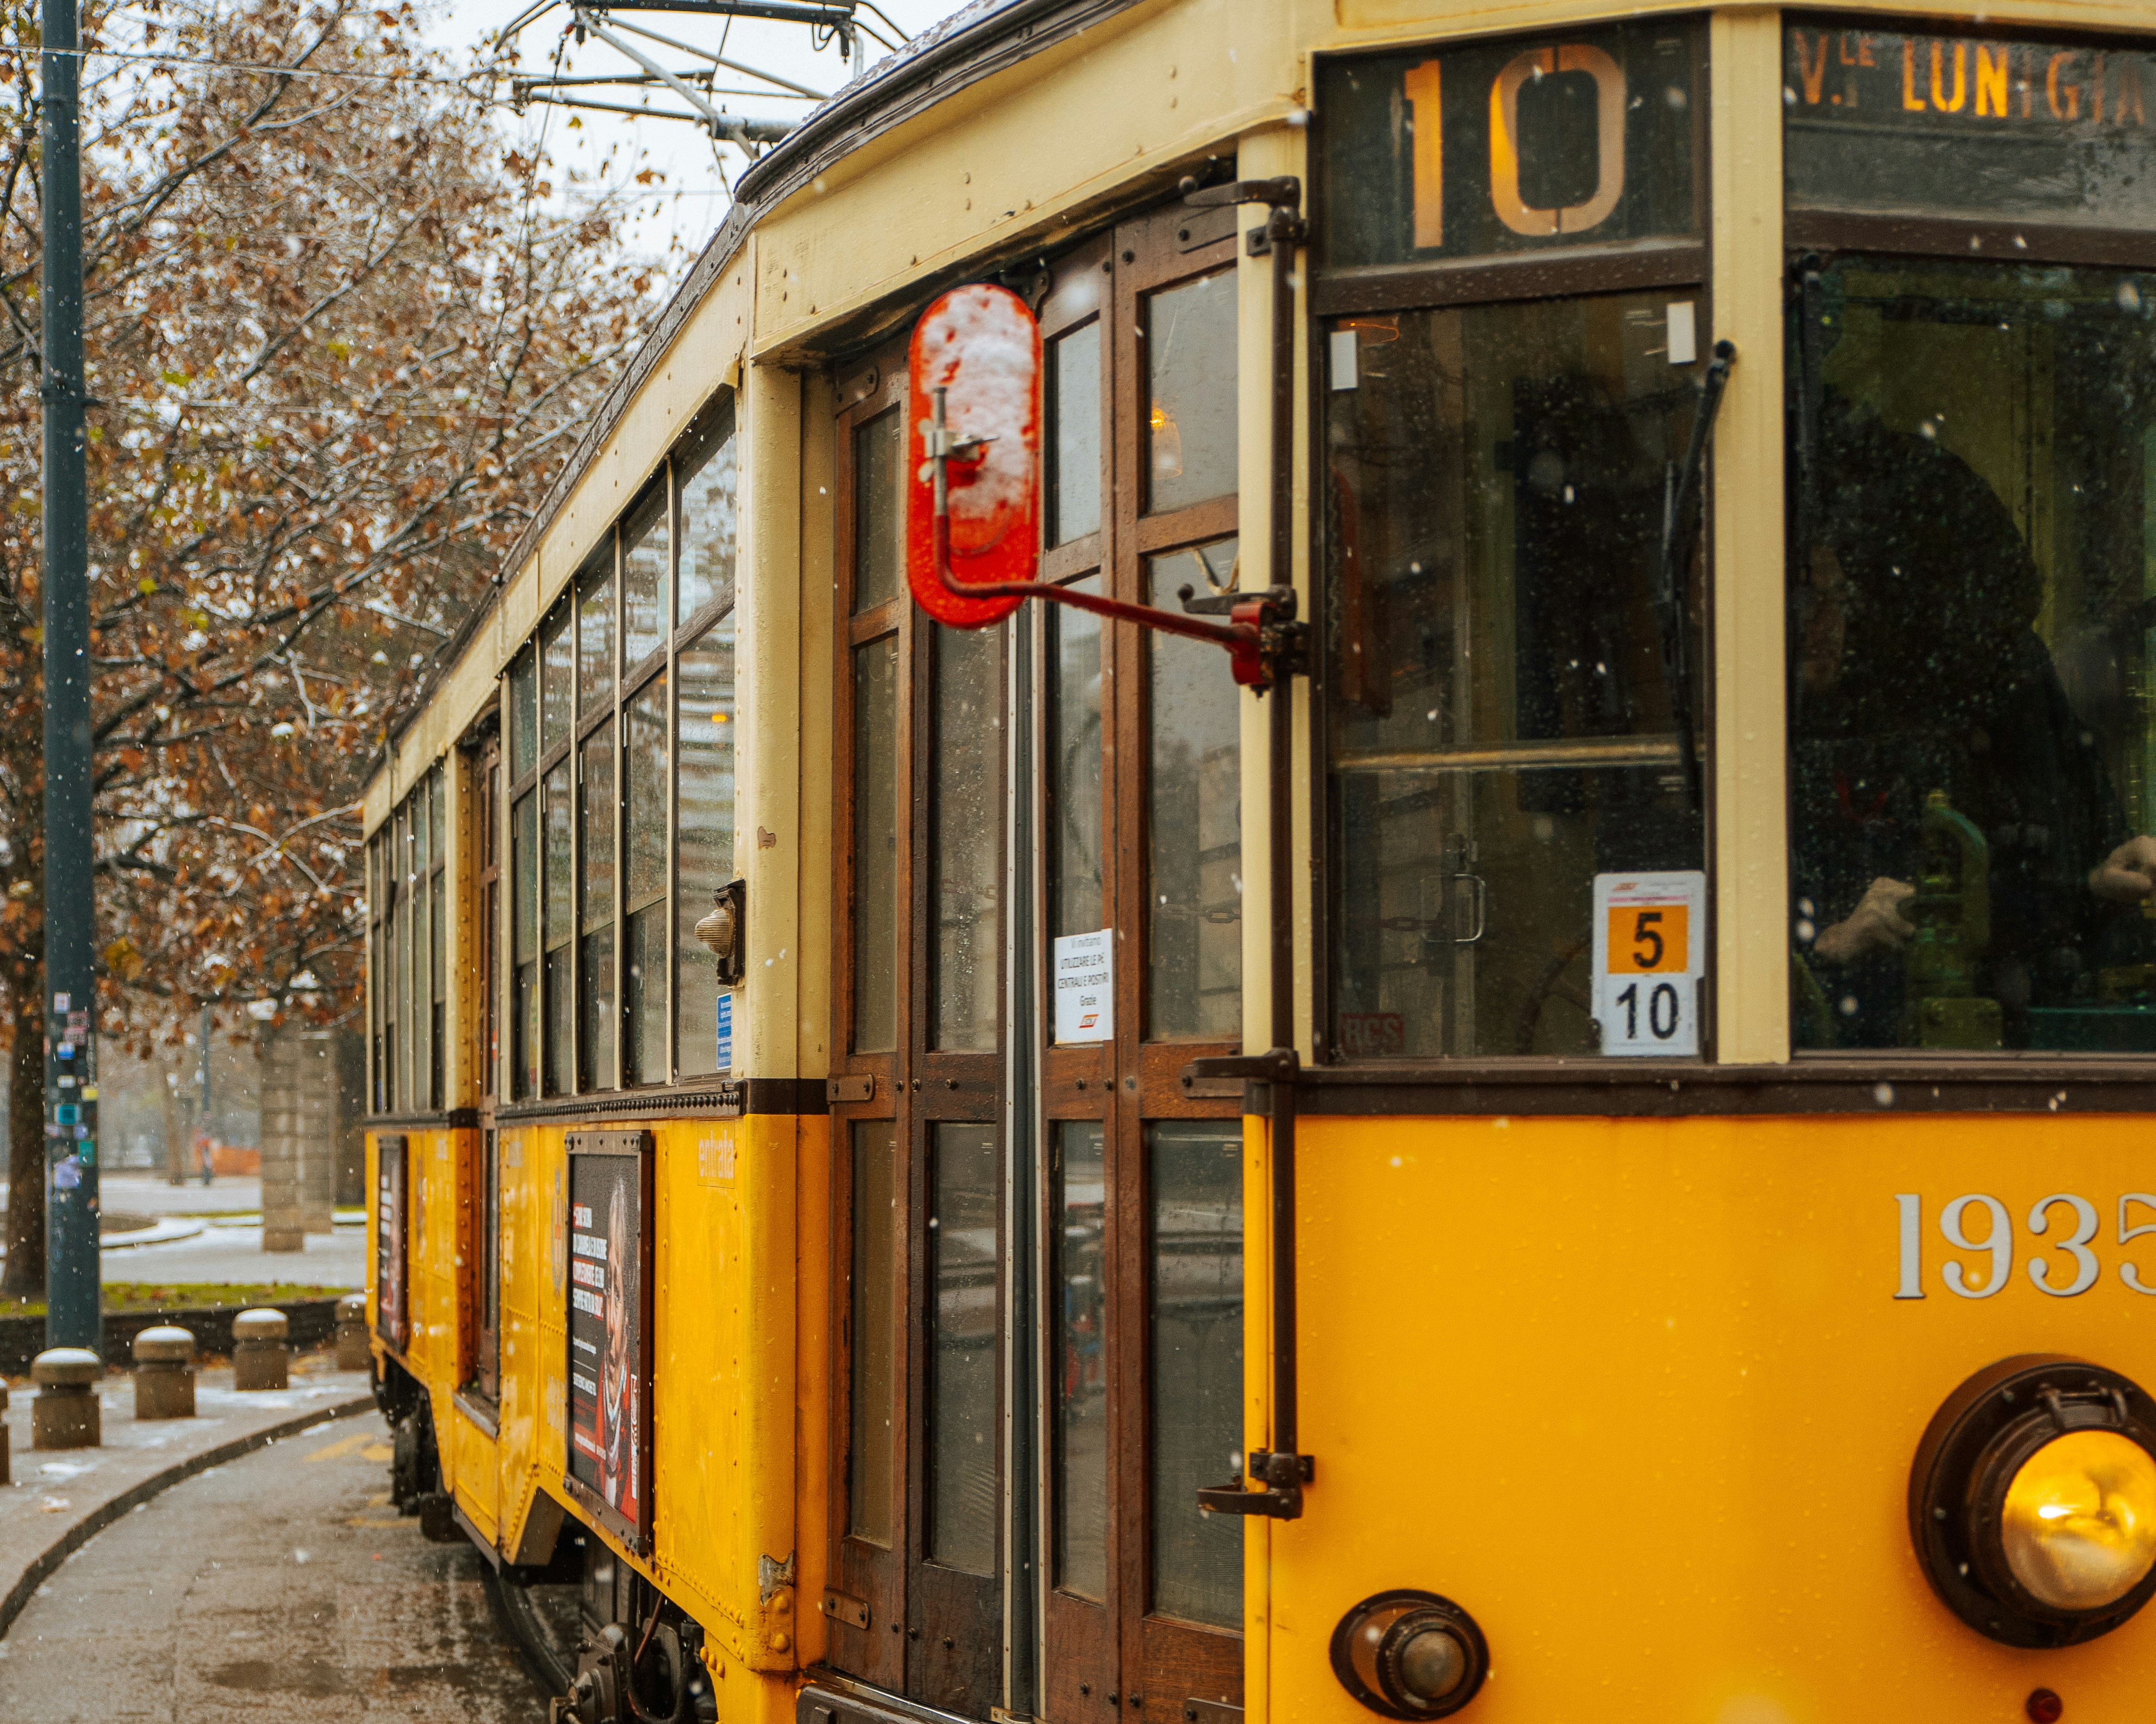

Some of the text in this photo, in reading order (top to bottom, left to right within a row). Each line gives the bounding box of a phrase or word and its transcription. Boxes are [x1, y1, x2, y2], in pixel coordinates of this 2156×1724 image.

[1405, 43, 1627, 248] 10
[1060, 955, 1089, 969] UTILIZZARE
[1090, 954, 1096, 966] LE
[1633, 911, 1664, 968] 5
[1079, 994, 1096, 1006] Grazie
[1616, 982, 1679, 1040] 10
[1893, 1192, 2156, 1300] 1935
